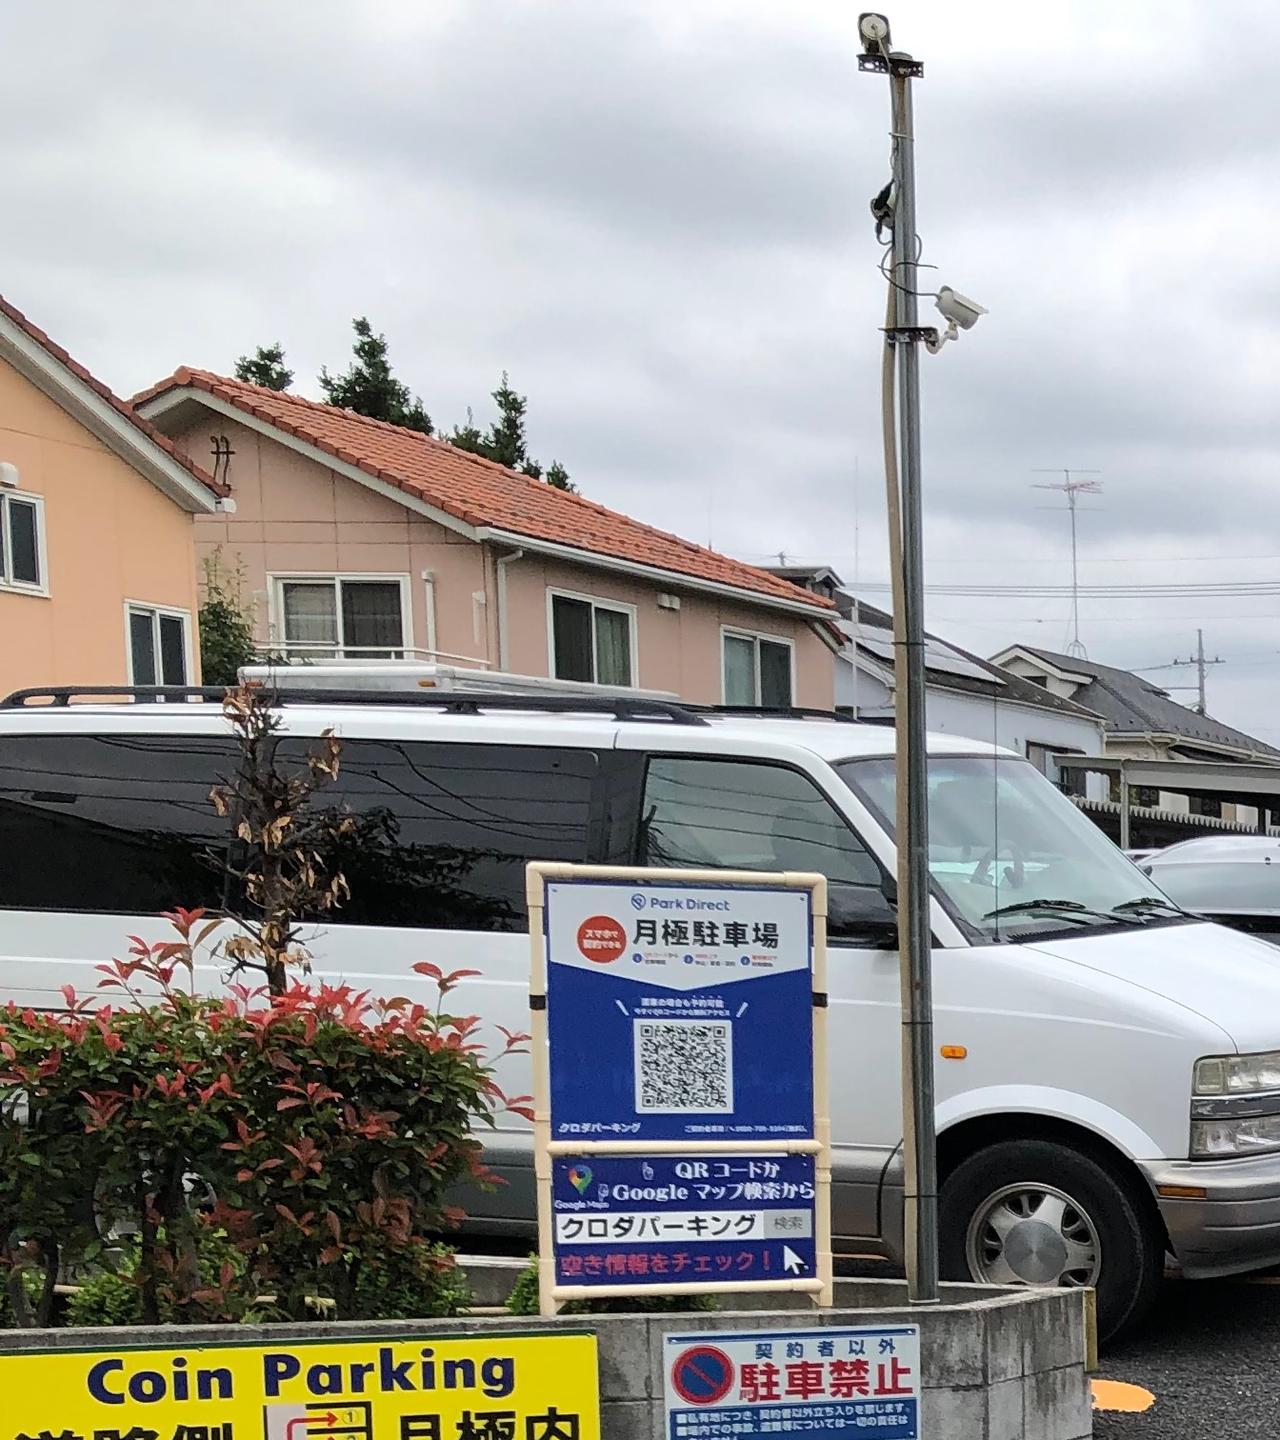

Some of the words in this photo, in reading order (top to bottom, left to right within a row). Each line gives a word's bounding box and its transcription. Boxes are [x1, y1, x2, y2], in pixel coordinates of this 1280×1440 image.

[650, 897, 684, 909] Park
[686, 898, 731, 911] Direct
[632, 918, 779, 949] 月極駐車場
[558, 1122, 641, 1134] クロダパーキング
[675, 1161, 710, 1180] QR
[713, 1161, 780, 1179] コードか
[612, 1184, 689, 1202] Google
[693, 1182, 815, 1200] マップ検索から
[560, 1215, 756, 1239] クロダパーキング
[755, 1338, 896, 1360] 契約者以外
[86, 1357, 235, 1405] Coin
[262, 1346, 516, 1398] Parking
[739, 1357, 914, 1402] 駐車禁止
